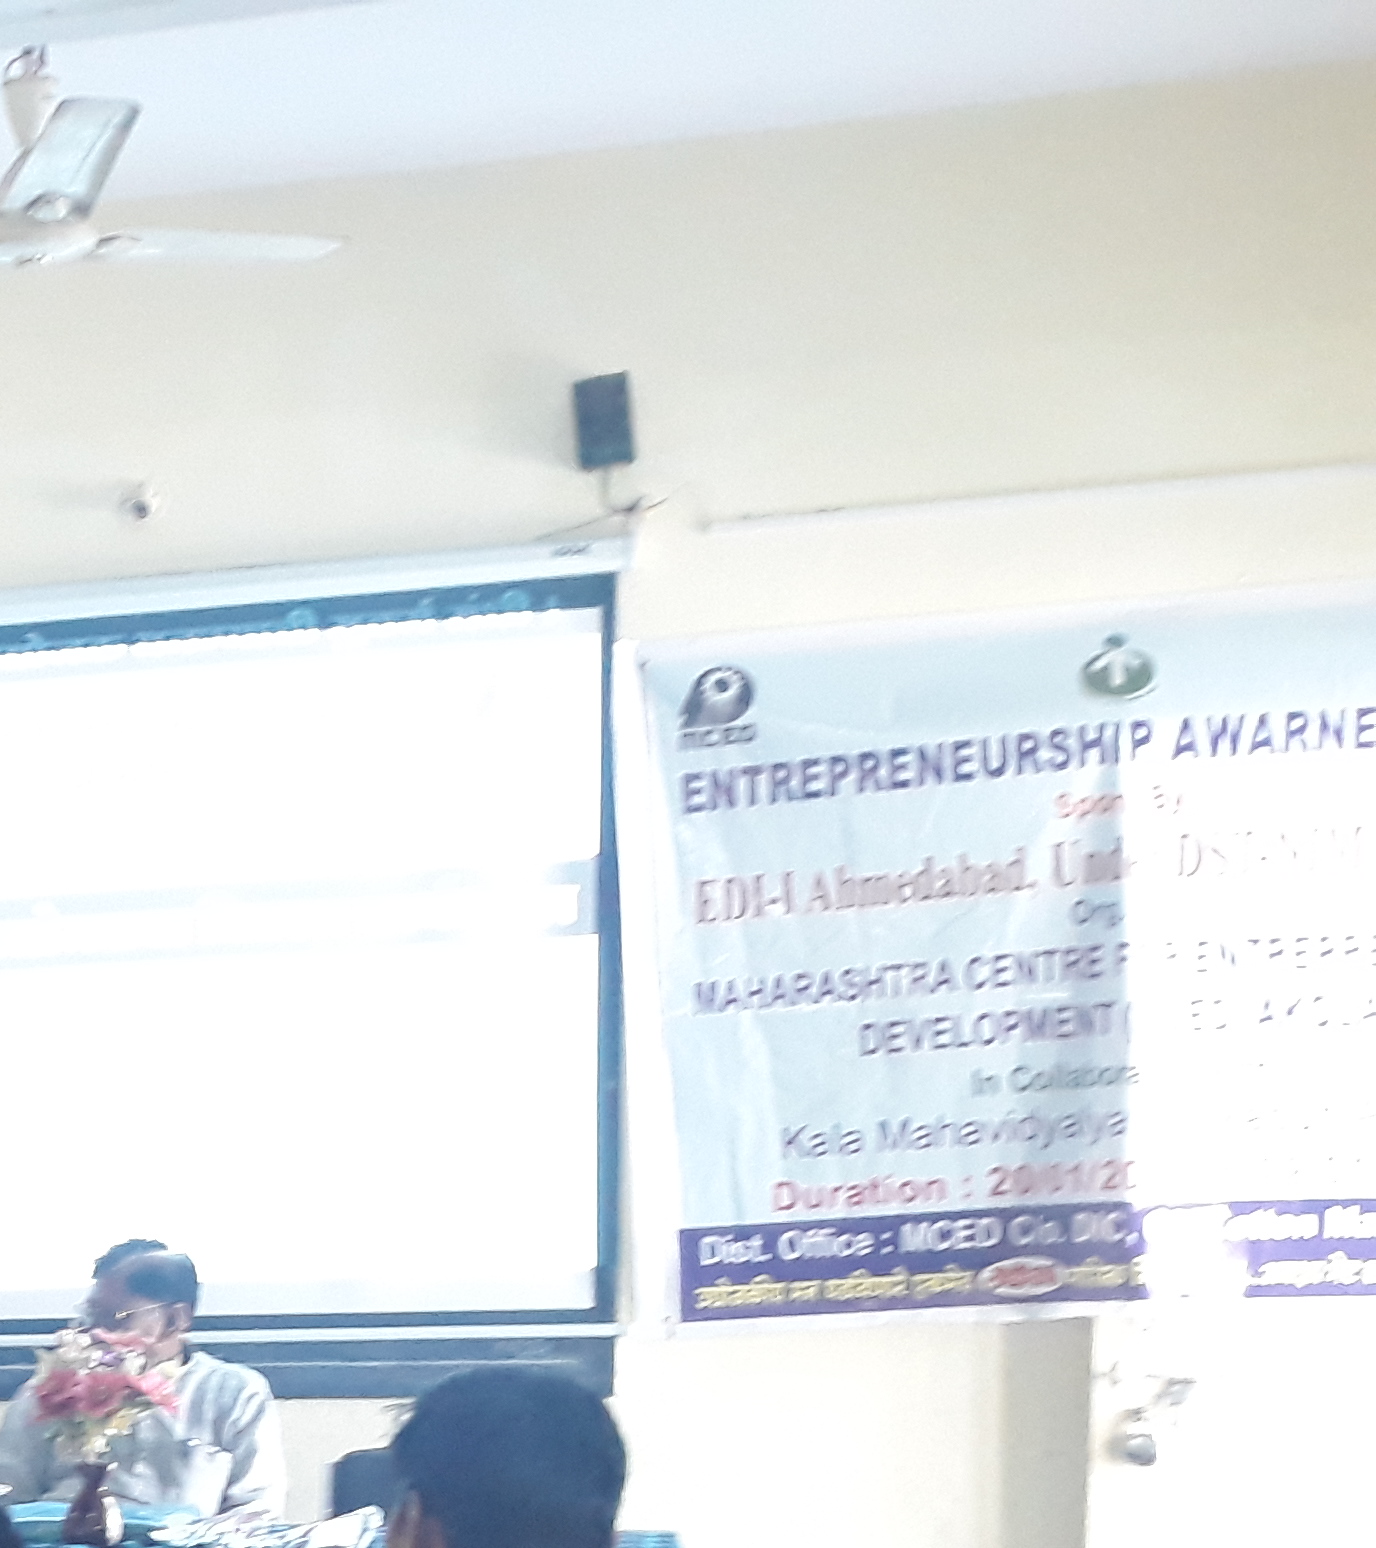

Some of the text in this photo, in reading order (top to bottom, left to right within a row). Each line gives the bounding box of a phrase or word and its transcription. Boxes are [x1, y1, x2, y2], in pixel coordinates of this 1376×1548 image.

[681, 717, 1153, 815] ENTREPRENEURSHIP
[691, 957, 952, 1016] MAHARASHTRA
[959, 942, 1106, 992] CENTRE
[858, 1000, 1120, 1056] DEVELOPMENT
[781, 1122, 864, 1159] Kala
[771, 1174, 950, 1213] Duration
[777, 1218, 876, 1261] Office
[899, 1216, 1004, 1253] MCED
